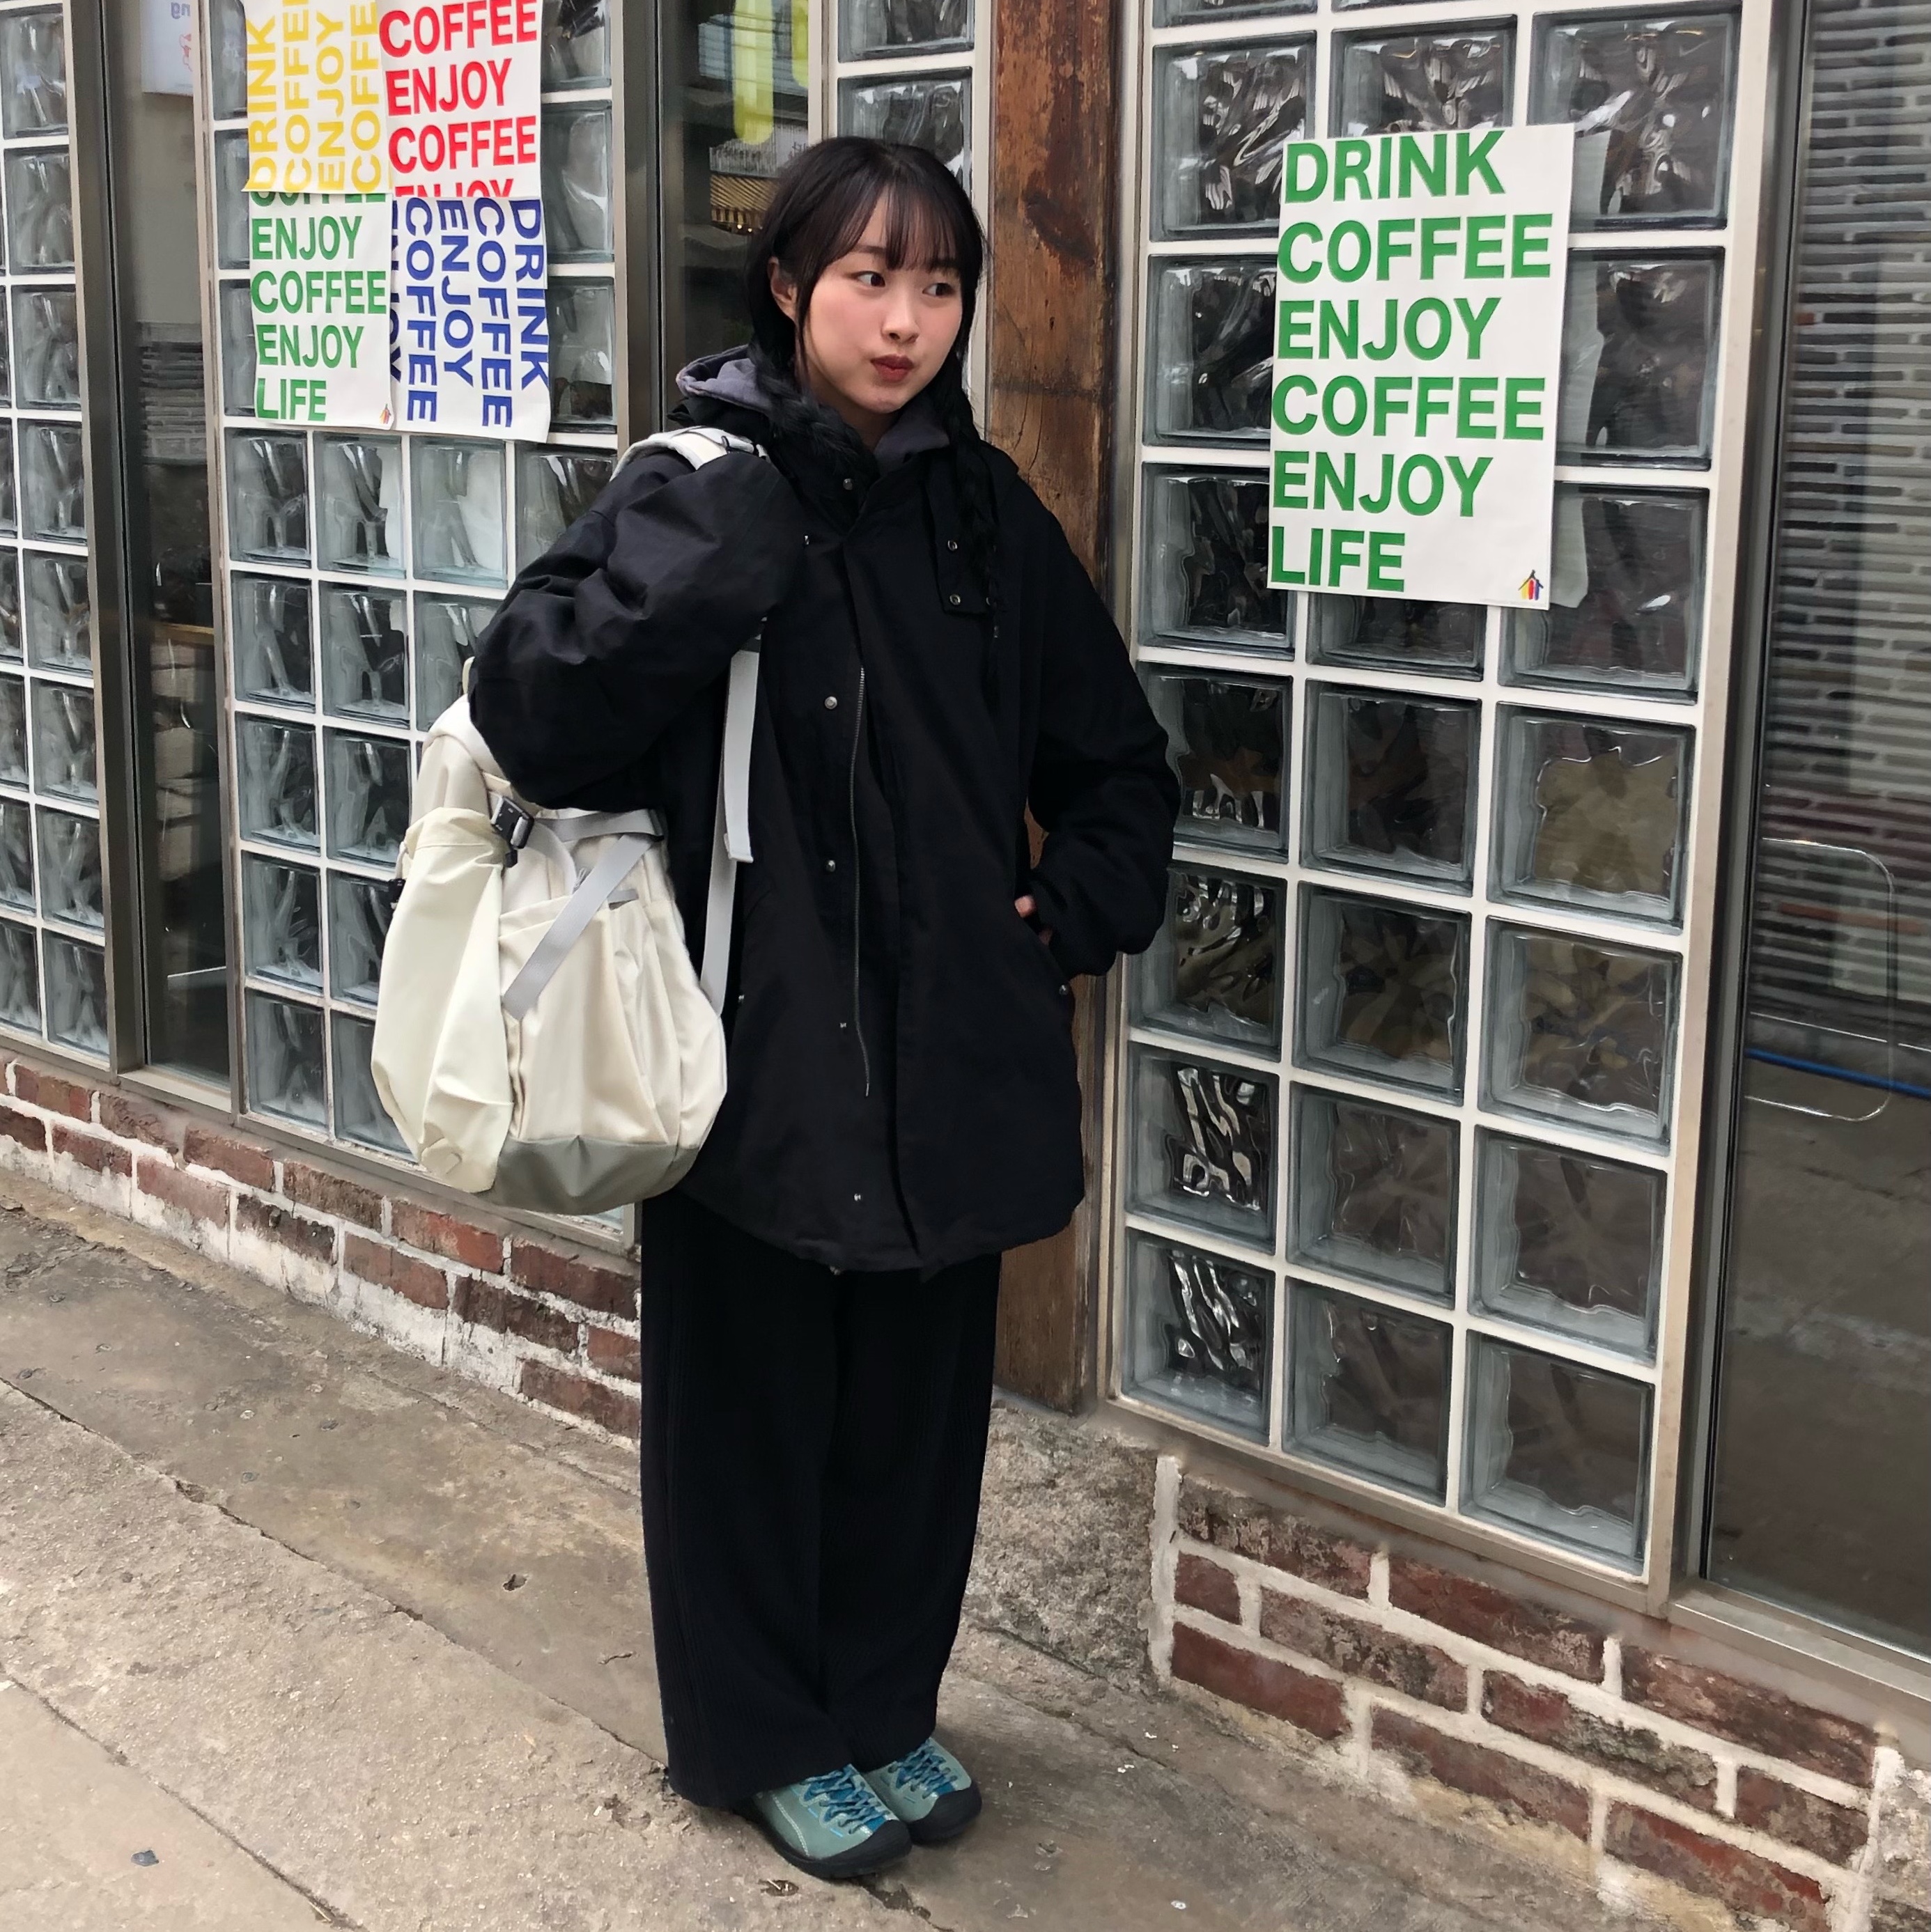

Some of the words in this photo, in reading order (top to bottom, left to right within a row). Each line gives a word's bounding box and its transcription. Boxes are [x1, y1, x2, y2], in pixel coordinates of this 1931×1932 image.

[379, 0, 538, 58] COFFEE
[245, 17, 279, 190] DRINK
[282, 0, 312, 193] COFFE
[316, 10, 346, 190] ENJOY
[385, 58, 512, 116] ENJOY
[388, 115, 537, 174] COFFEE
[1285, 130, 1505, 203] DRINK
[252, 216, 363, 260] ENJOY
[1276, 213, 1553, 283] COFFEE
[251, 270, 387, 314] COFFEE
[405, 197, 438, 422] COFFEE
[437, 200, 474, 387] ENJOY
[474, 197, 513, 428] COFFEE
[509, 199, 550, 391] DRINK
[256, 325, 365, 368] ENJOY
[1278, 297, 1501, 361] ENJOY
[256, 378, 327, 422] LIFE
[1272, 375, 1546, 440] COFFEE
[1273, 451, 1493, 517] ENJOY
[1271, 526, 1406, 592] LIFE
